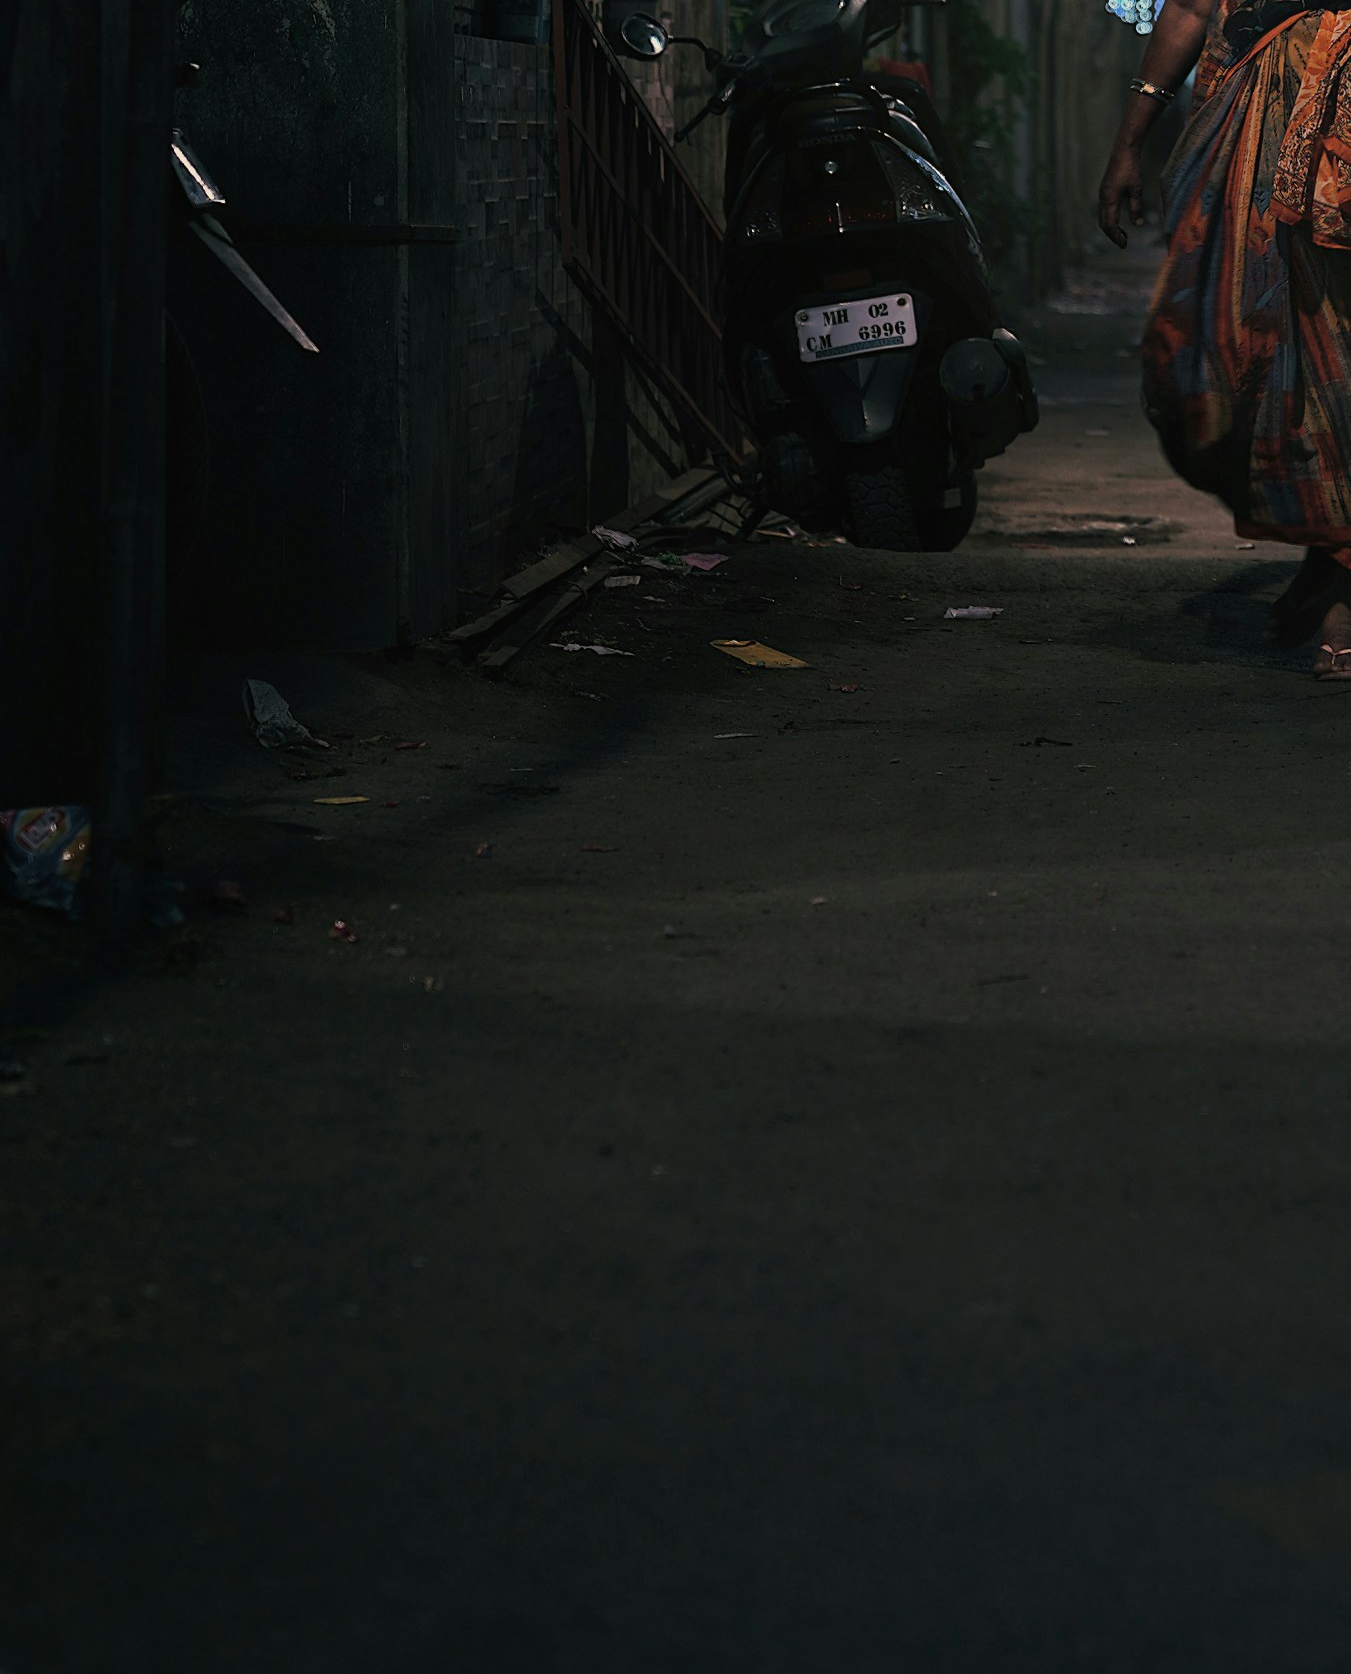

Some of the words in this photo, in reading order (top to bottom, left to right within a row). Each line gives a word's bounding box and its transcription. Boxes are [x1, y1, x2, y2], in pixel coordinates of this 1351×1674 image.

[798, 133, 857, 149] HONDA
[823, 309, 849, 326] MH
[868, 303, 888, 318] 02
[806, 334, 832, 351] CM
[858, 321, 906, 340] 6996
